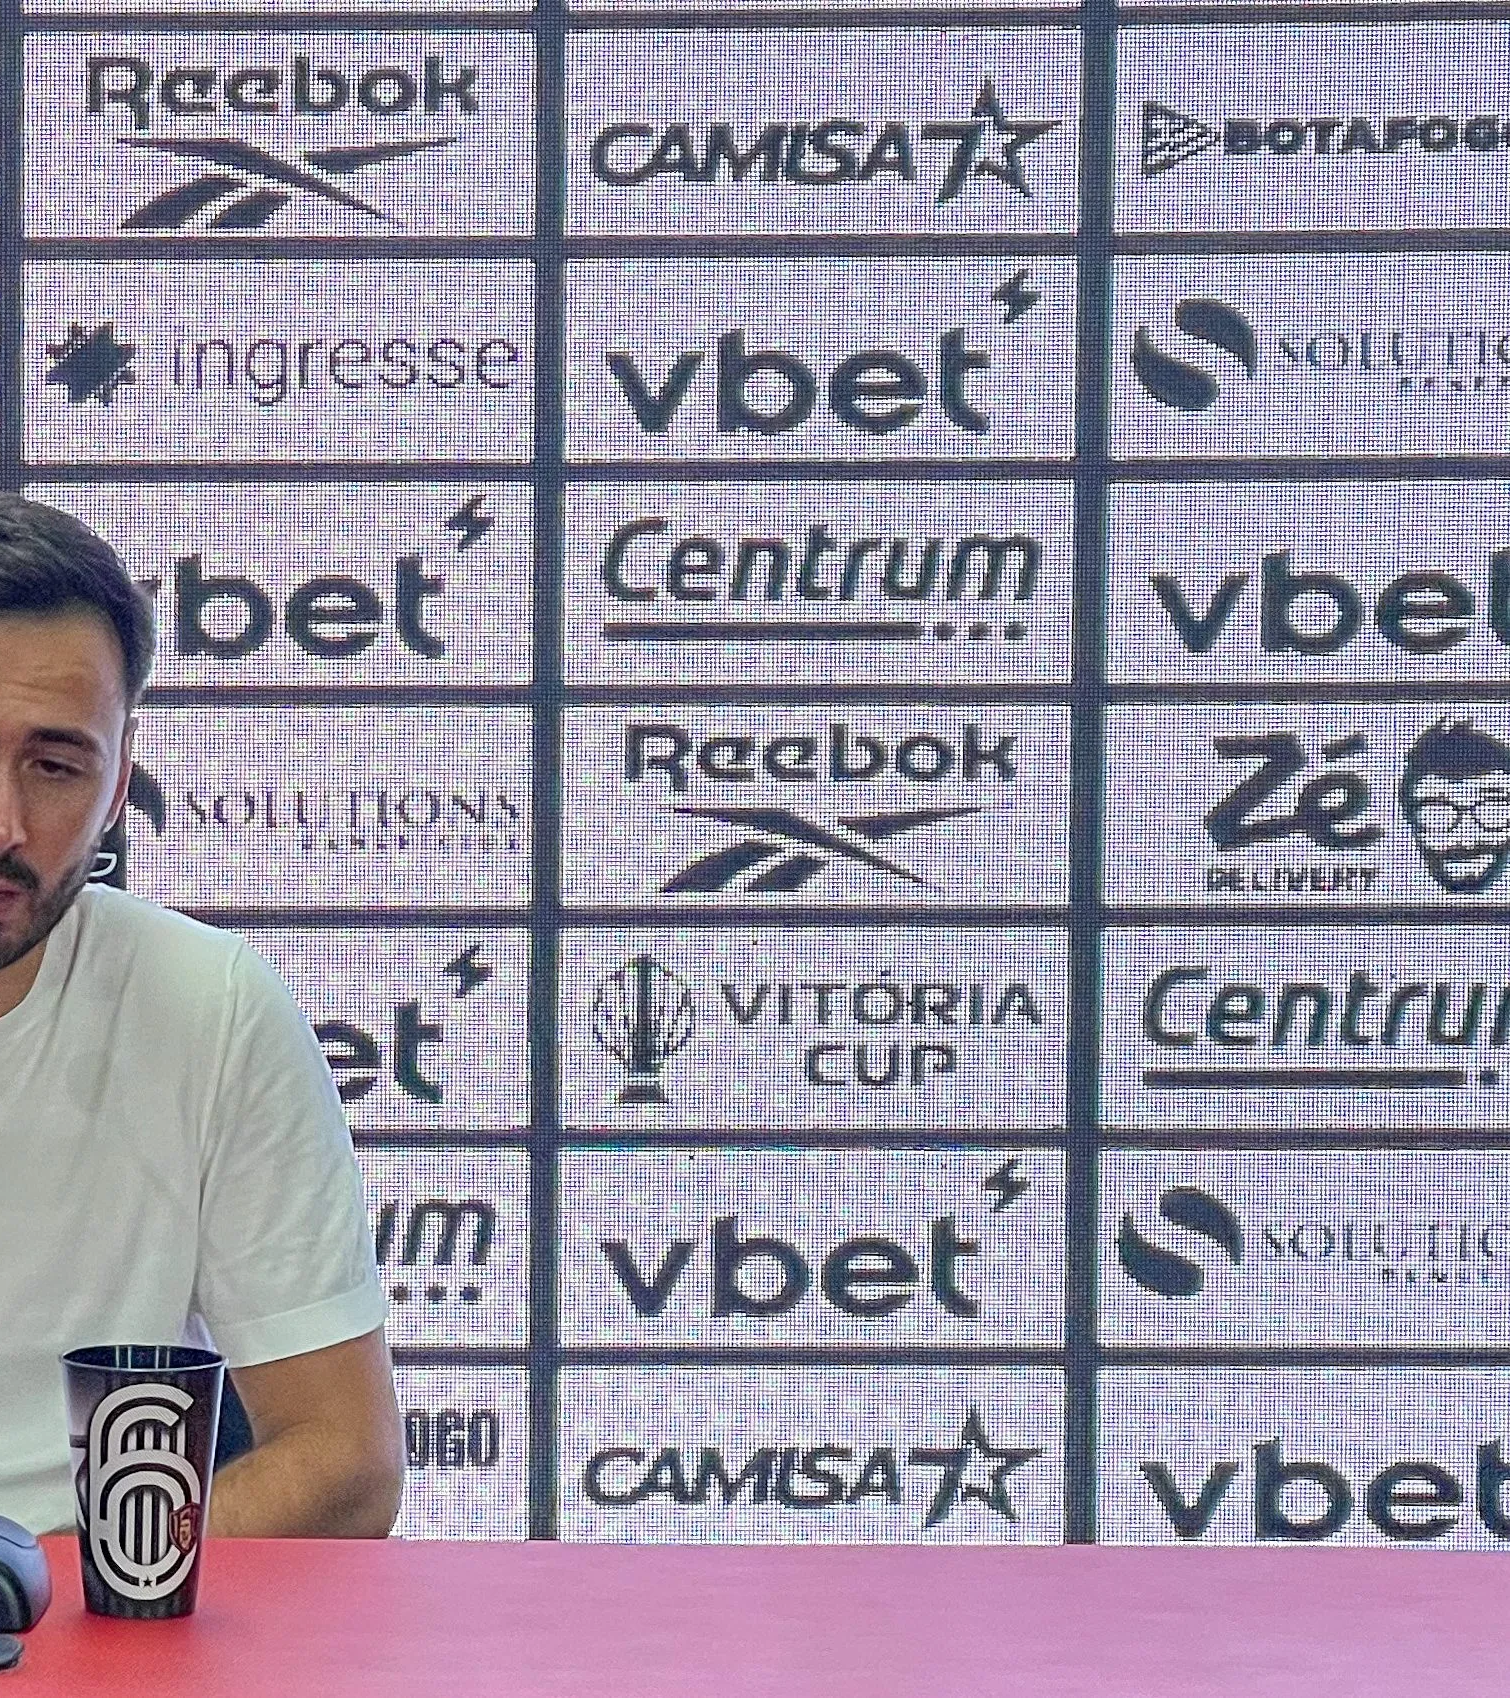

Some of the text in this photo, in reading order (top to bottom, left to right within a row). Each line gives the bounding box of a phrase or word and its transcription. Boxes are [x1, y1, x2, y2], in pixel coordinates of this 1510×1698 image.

[86, 56, 478, 130] Reebok
[1224, 116, 1510, 155] BOTAFOG
[173, 338, 519, 407] ingresse
[606, 328, 989, 436] vbet
[601, 518, 1042, 601] Centrum
[145, 554, 444, 662] bet
[625, 724, 1016, 792] Reebok
[1204, 733, 1384, 851] Zé
[186, 791, 519, 829] SOLUTIONS
[721, 970, 1042, 1025] VITÓRIA
[1143, 967, 1510, 1048] Centru
[804, 1043, 956, 1089] CUP
[601, 1216, 979, 1318] vbet
